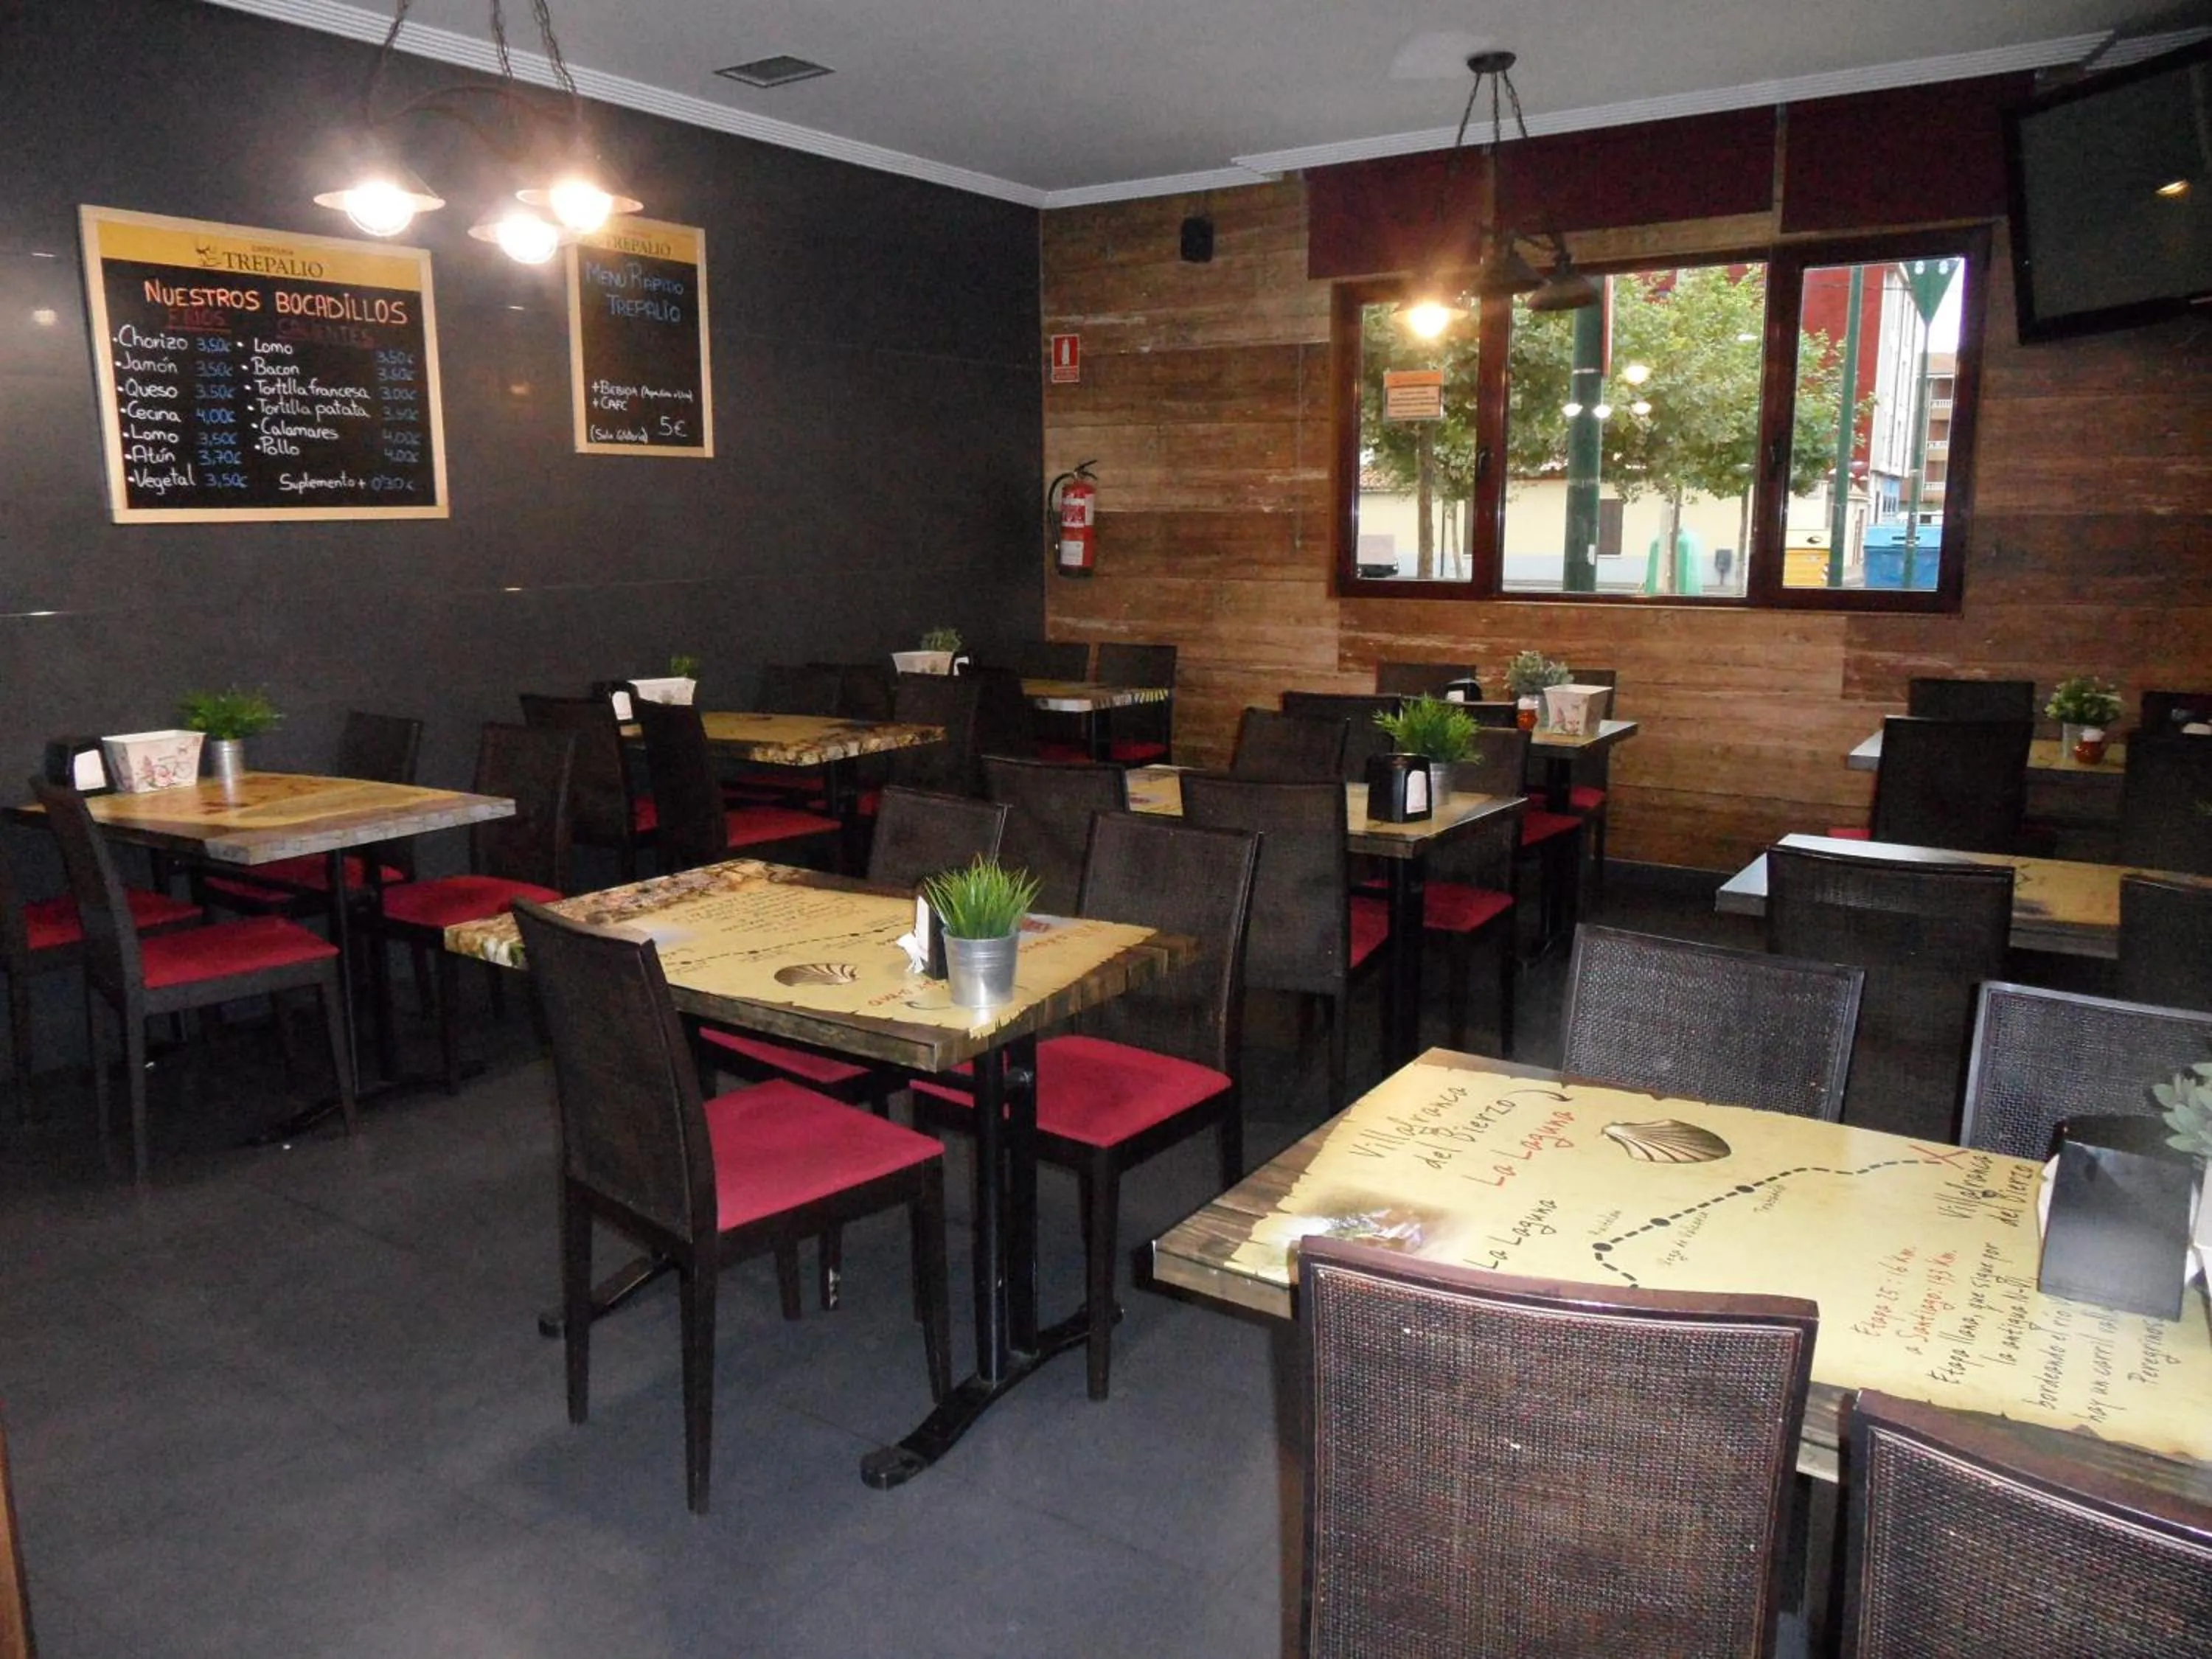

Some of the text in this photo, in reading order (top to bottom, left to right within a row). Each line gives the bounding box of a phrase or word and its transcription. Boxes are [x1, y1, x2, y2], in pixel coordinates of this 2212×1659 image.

[223, 251, 324, 277] TREPALIO
[144, 278, 408, 324] NUESTROS BOCADILLOS
[118, 324, 188, 349] Chorizo
[254, 338, 293, 355] Lomo
[122, 351, 178, 374] Jamón
[251, 356, 300, 375] Bacon
[125, 378, 178, 398] Queso
[254, 377, 308, 395] Tortilla
[308, 377, 370, 400] francesa
[128, 400, 181, 422] Cecina
[256, 395, 310, 415] Tortilla
[316, 399, 371, 422] patata
[131, 423, 180, 443] Lomo
[260, 417, 339, 440] Calamares
[658, 415, 687, 437] 5€
[132, 445, 175, 464] Atún
[260, 436, 301, 456] Pollo
[133, 462, 196, 495] Vegetal
[1349, 1086, 1470, 1158] Villafranca
[1413, 1098, 1516, 1169] del Bierzo
[1462, 1110, 1576, 1186] La Laguna
[1935, 1155, 1994, 1219] Villafranca
[1986, 1164, 2034, 1227] del Bierzo
[1463, 1197, 1559, 1270] La Laguna
[1982, 1241, 2014, 1263] por
[1969, 1292, 2004, 1313] que
[1851, 1304, 1905, 1337] Etapa
[1979, 1352, 2017, 1366] la
[1998, 1305, 2041, 1350] antigua
[1926, 1349, 1985, 1384] Etapa
[2078, 1332, 2115, 1377] carril
[2021, 1345, 2066, 1410] bordeando
[2090, 1380, 2110, 1395] un
[2071, 1398, 2127, 1423] hay
